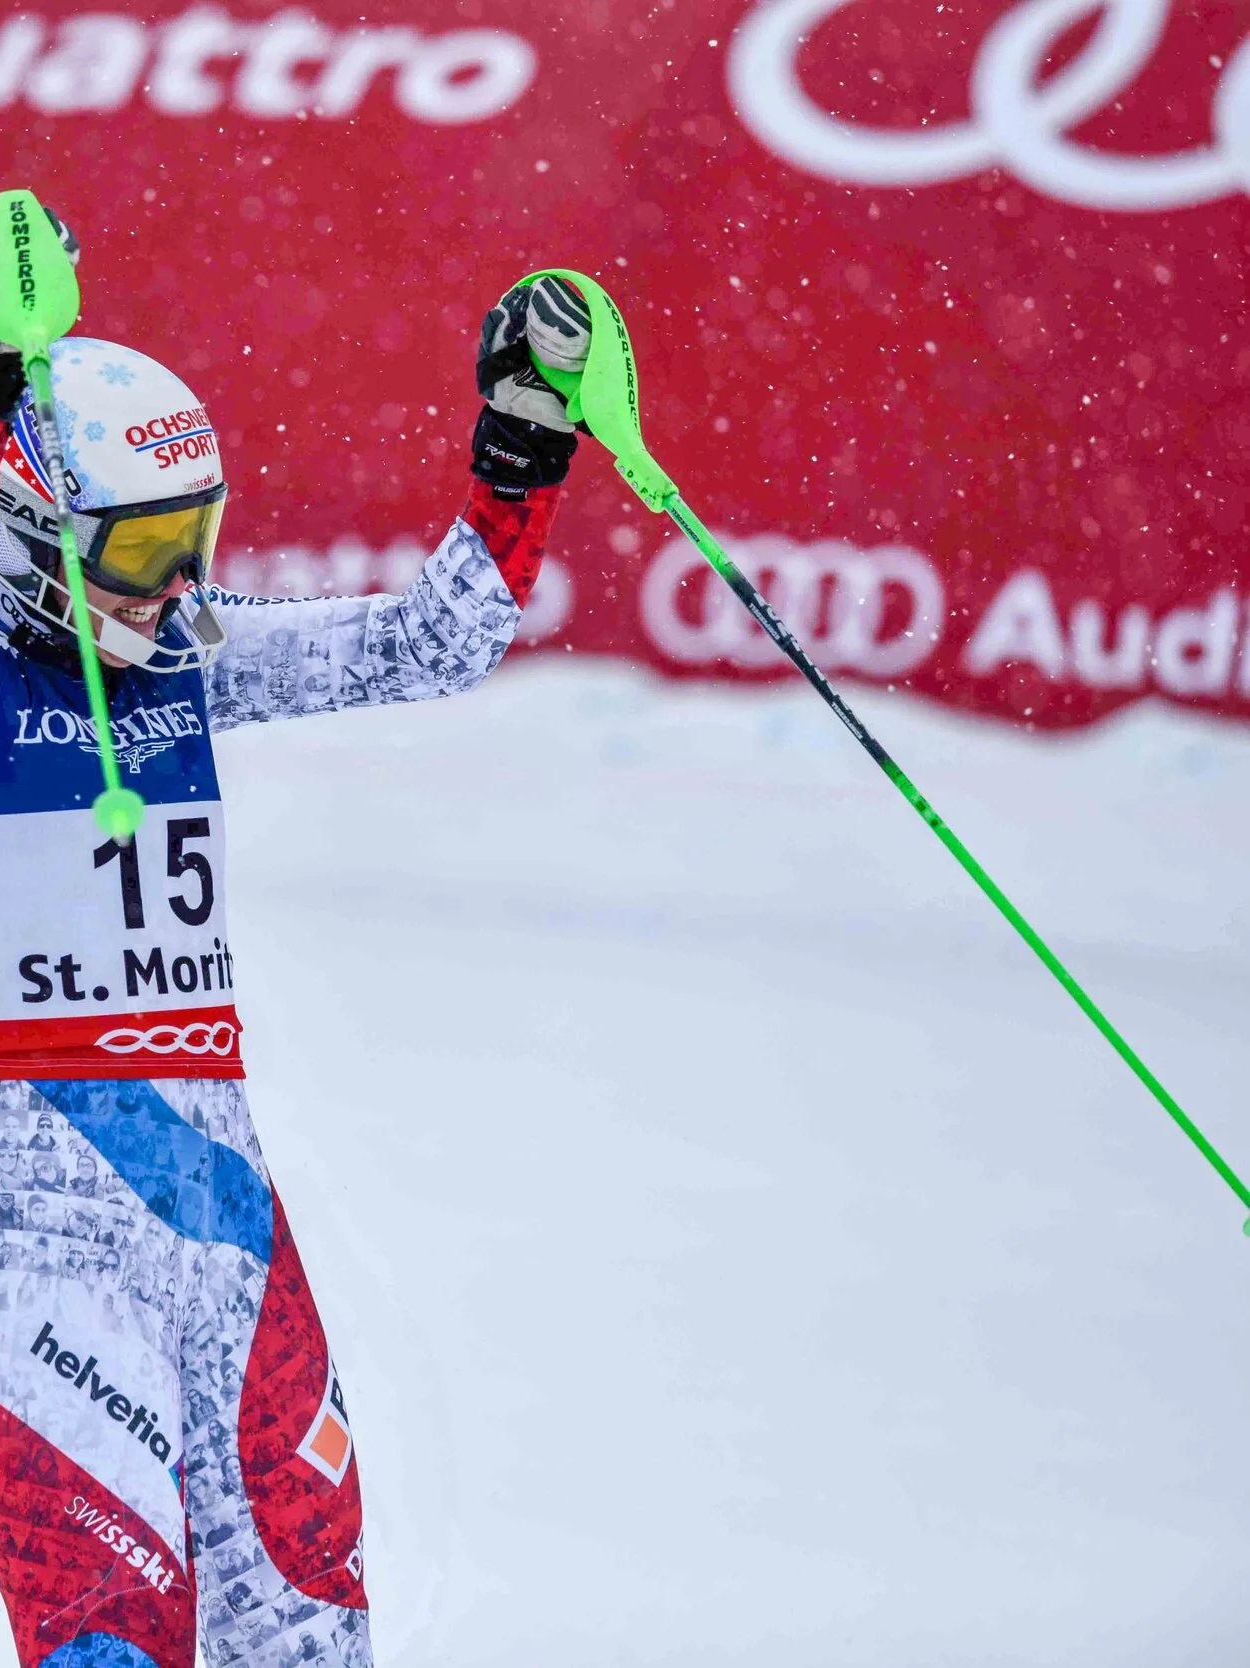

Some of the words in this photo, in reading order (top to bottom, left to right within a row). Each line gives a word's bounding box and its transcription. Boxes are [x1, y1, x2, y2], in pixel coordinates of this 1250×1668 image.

[153, 433, 216, 469] SPORT
[485, 443, 530, 464] RACE
[92, 816, 214, 930] 15
[18, 953, 110, 1003] St.
[123, 936, 234, 998] Morit
[29, 1322, 172, 1465] helvetia
[64, 1496, 174, 1595] swissski
